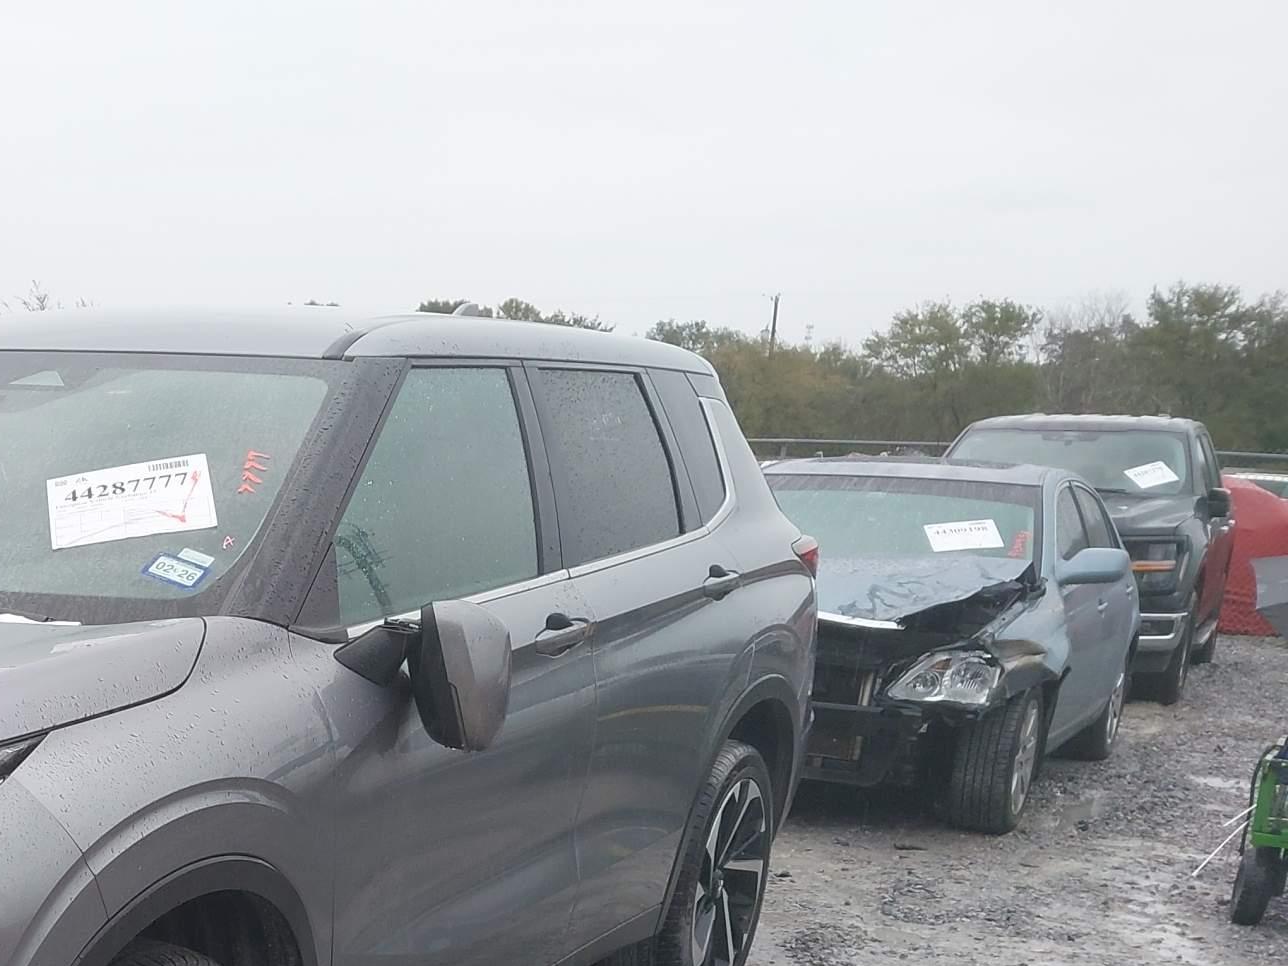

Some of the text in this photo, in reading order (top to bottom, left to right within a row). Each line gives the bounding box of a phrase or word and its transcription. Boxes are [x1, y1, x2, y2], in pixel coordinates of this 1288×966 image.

[64, 472, 189, 502] 44287777
[155, 560, 199, 583] 02 26
